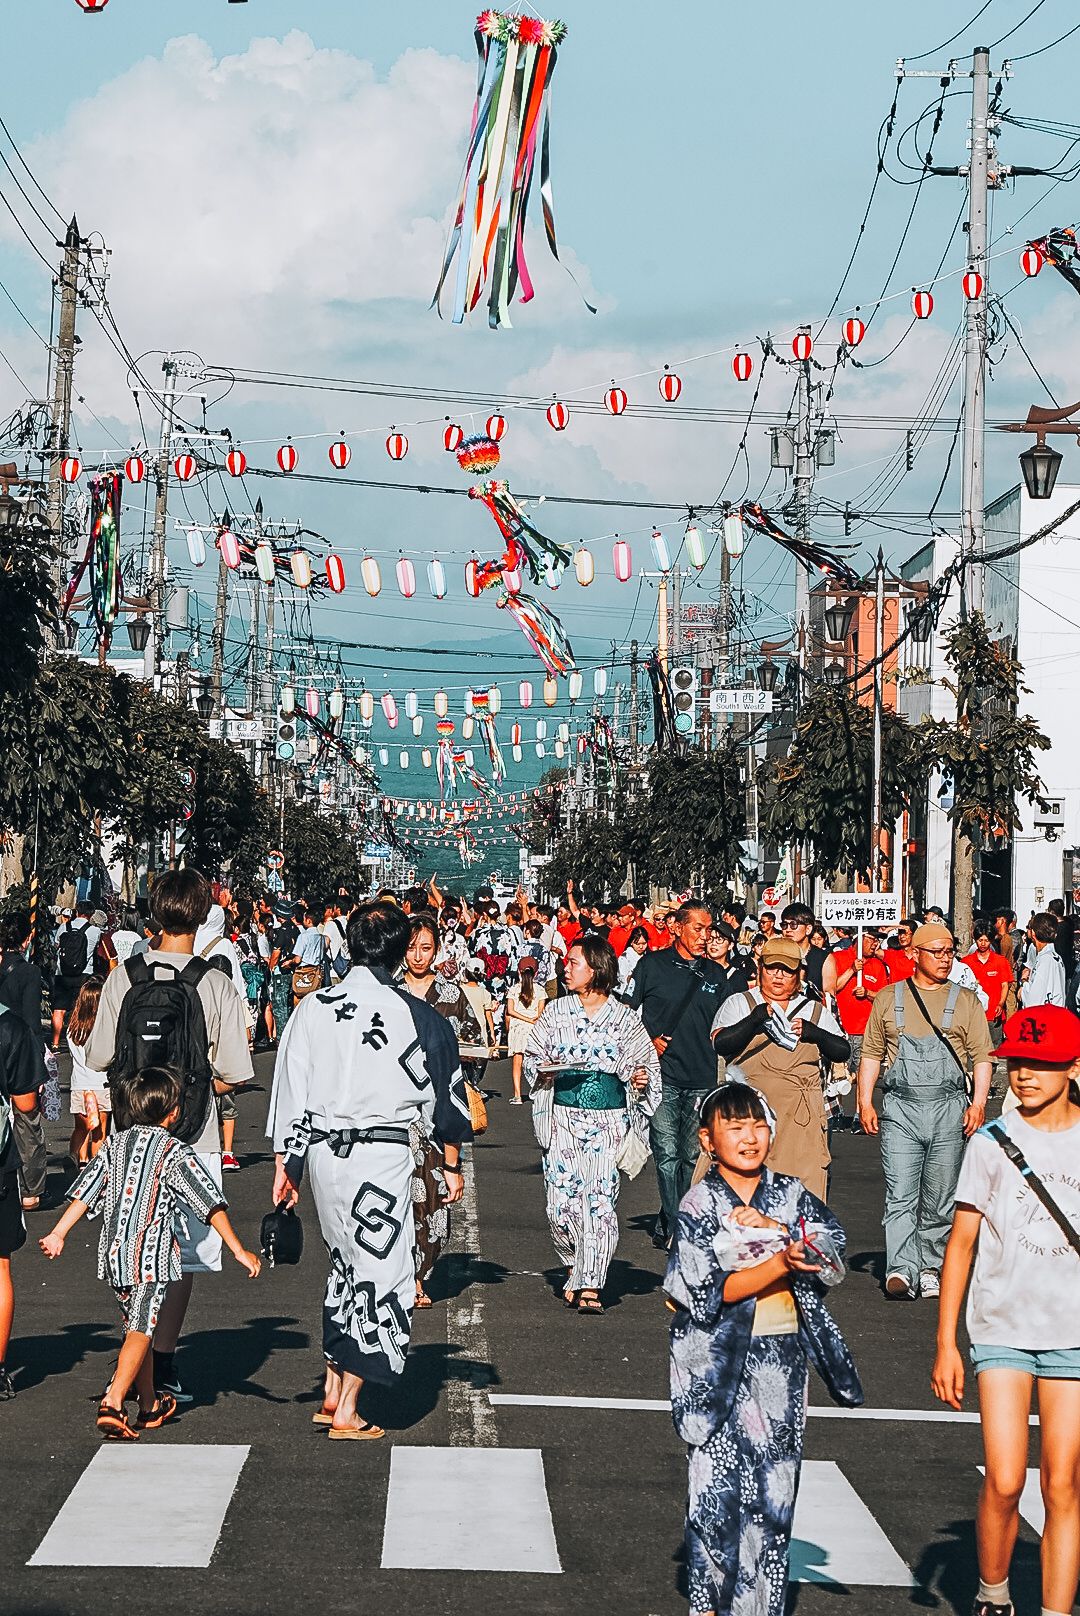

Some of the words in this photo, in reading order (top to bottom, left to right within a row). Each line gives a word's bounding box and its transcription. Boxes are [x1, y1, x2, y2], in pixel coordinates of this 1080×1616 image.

[715, 692, 767, 704] 南1西2
[825, 907, 897, 921] じゃが祭り有志
